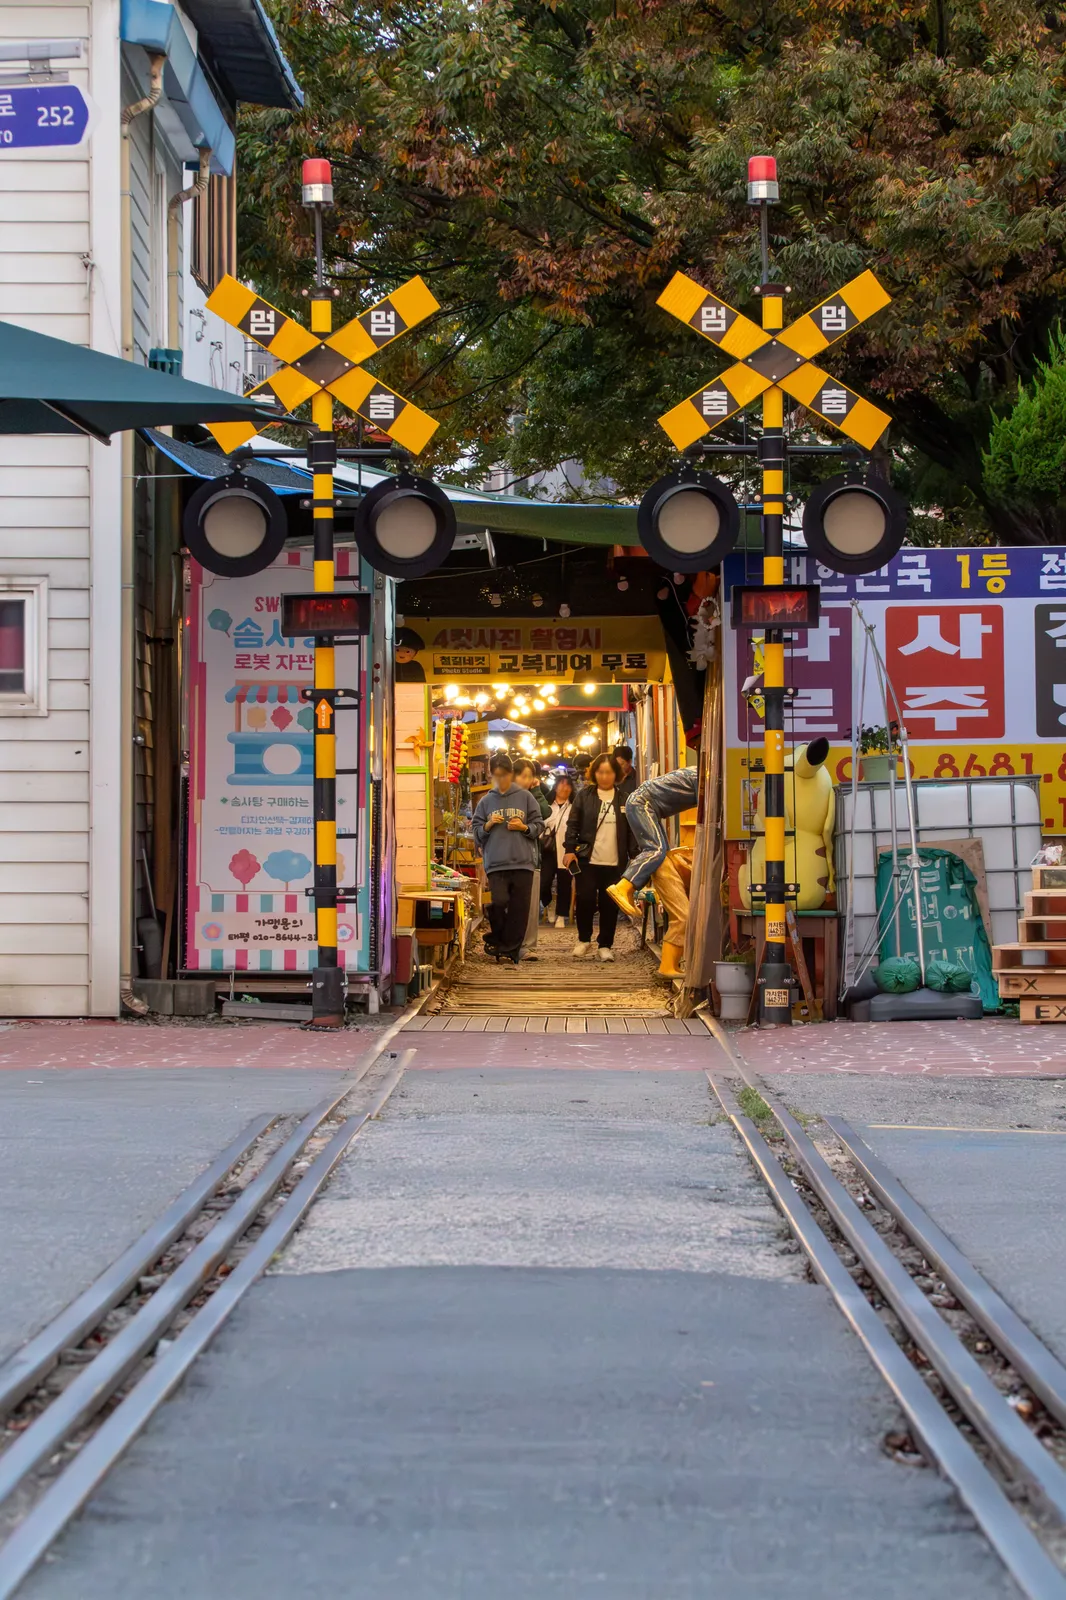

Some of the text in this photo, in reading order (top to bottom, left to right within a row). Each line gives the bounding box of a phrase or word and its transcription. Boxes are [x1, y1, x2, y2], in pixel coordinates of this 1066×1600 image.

[37, 105, 74, 127] 252
[956, 554, 1012, 594] 1등
[234, 653, 270, 671] 로봇
[497, 653, 648, 674] 교복대여 무료
[231, 796, 309, 808] 솜사탕 구매하는
[255, 917, 303, 931] 가맹문의
[1035, 1005, 1066, 1020] EX
